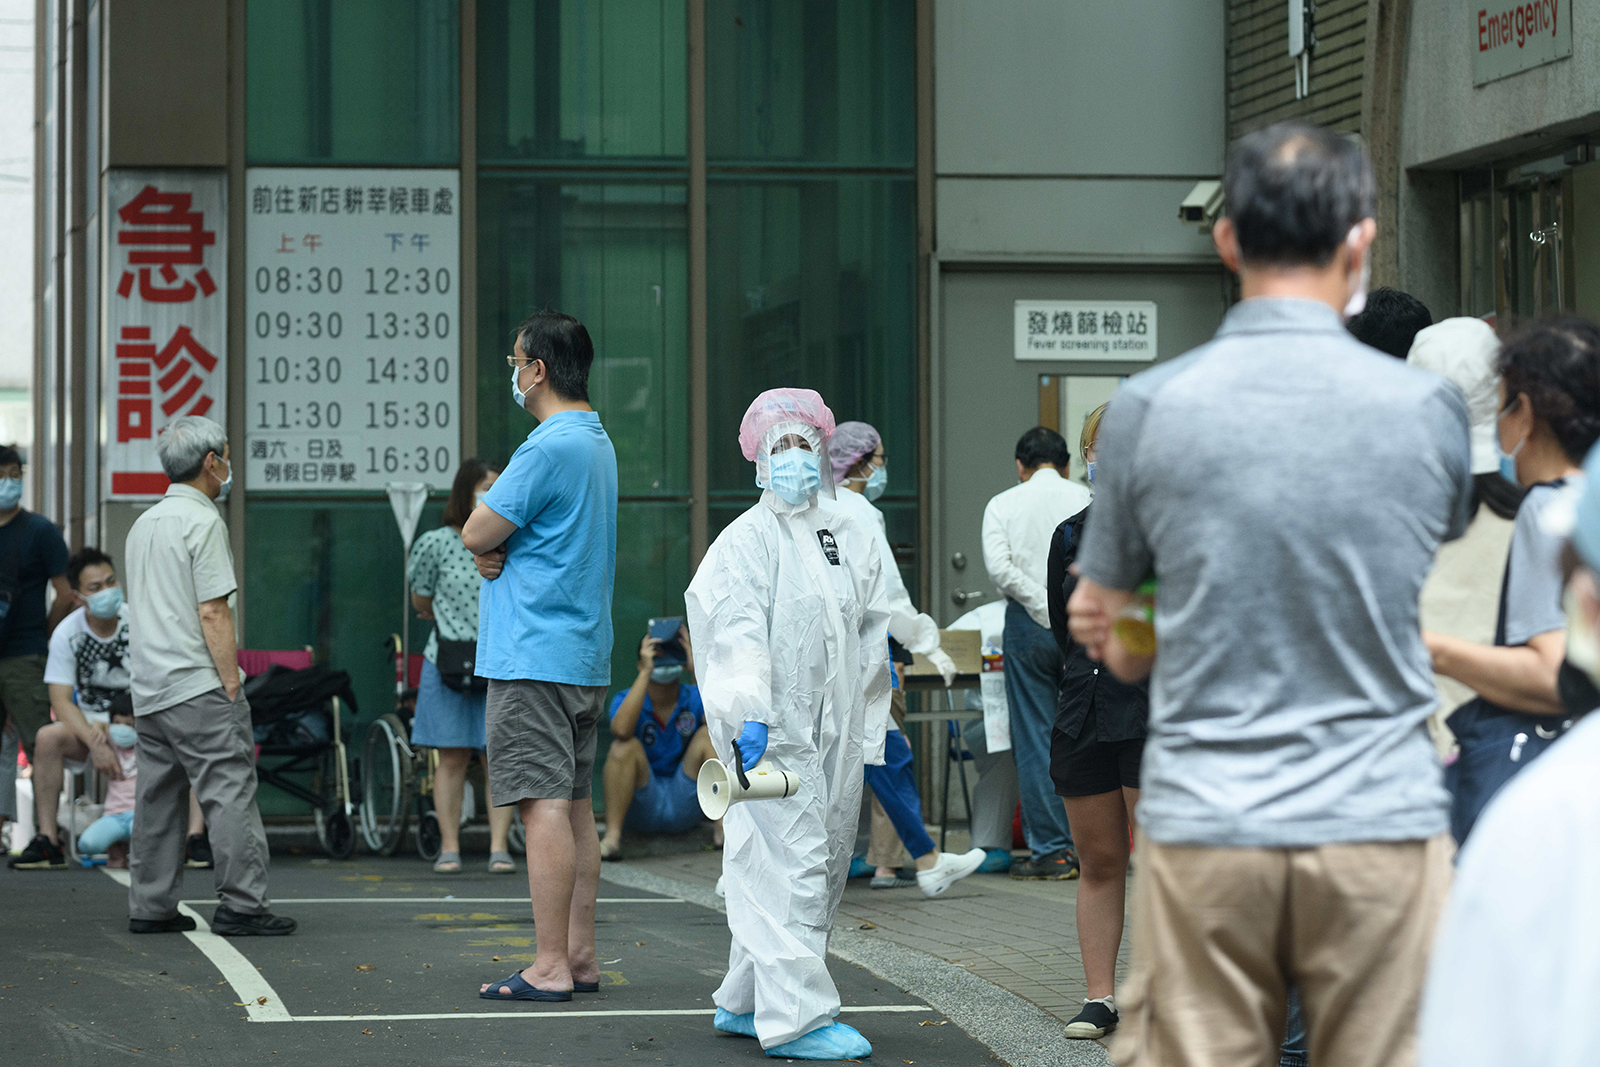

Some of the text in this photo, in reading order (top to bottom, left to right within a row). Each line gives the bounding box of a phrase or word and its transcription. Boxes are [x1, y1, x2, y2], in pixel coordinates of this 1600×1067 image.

[1478, 0, 1558, 52] Emergency
[252, 185, 454, 216] 前往新店耕莘候車處
[276, 232, 431, 254] 上午 下午
[255, 267, 451, 295] 08:30 12:30
[116, 185, 218, 443] 急診
[255, 311, 451, 339] 09:30 13:30
[1027, 310, 1148, 336] 發燒篩檢站
[1027, 337, 1148, 354] Fever screening station
[255, 356, 451, 384] 10:30 14:30
[255, 401, 451, 429] 11:30 15:30
[264, 462, 357, 484] 例假日停駛
[365, 446, 451, 474] 16:30
